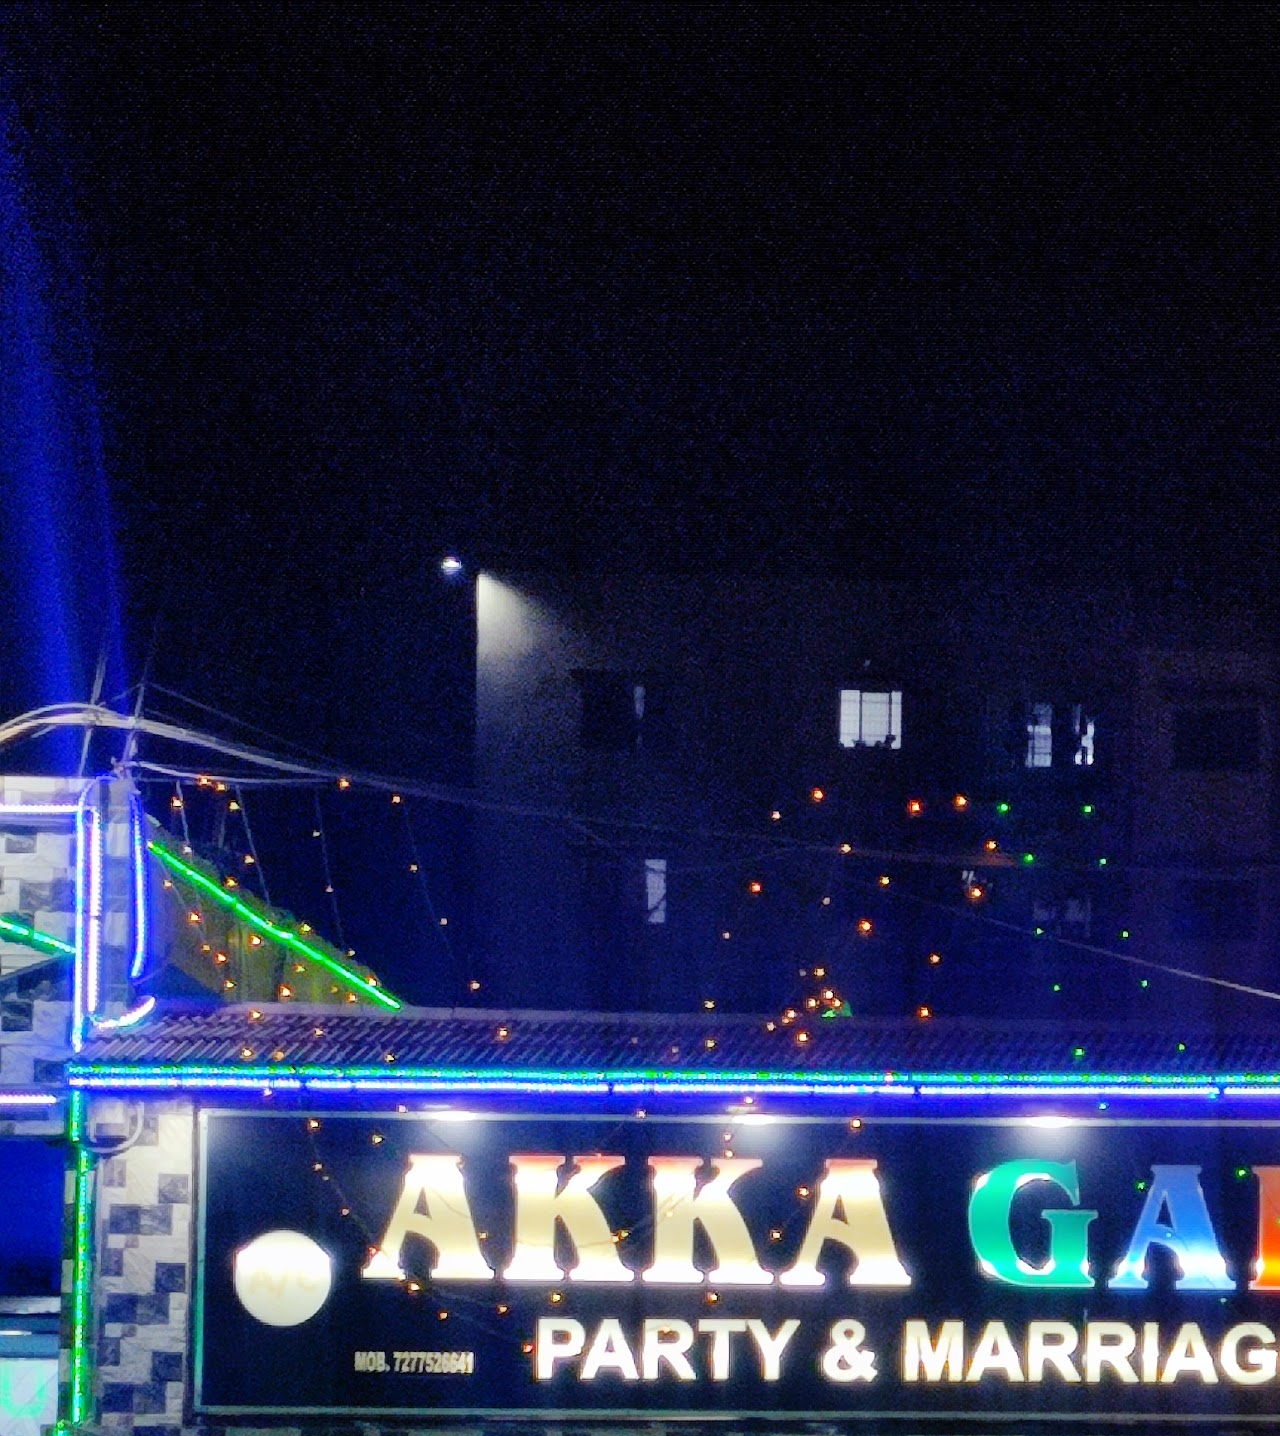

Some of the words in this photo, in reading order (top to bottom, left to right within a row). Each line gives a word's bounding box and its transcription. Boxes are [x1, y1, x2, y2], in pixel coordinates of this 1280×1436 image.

[361, 1153, 912, 1285] AKKA
[535, 1318, 801, 1382] PARTY
[822, 1318, 877, 1384] &
